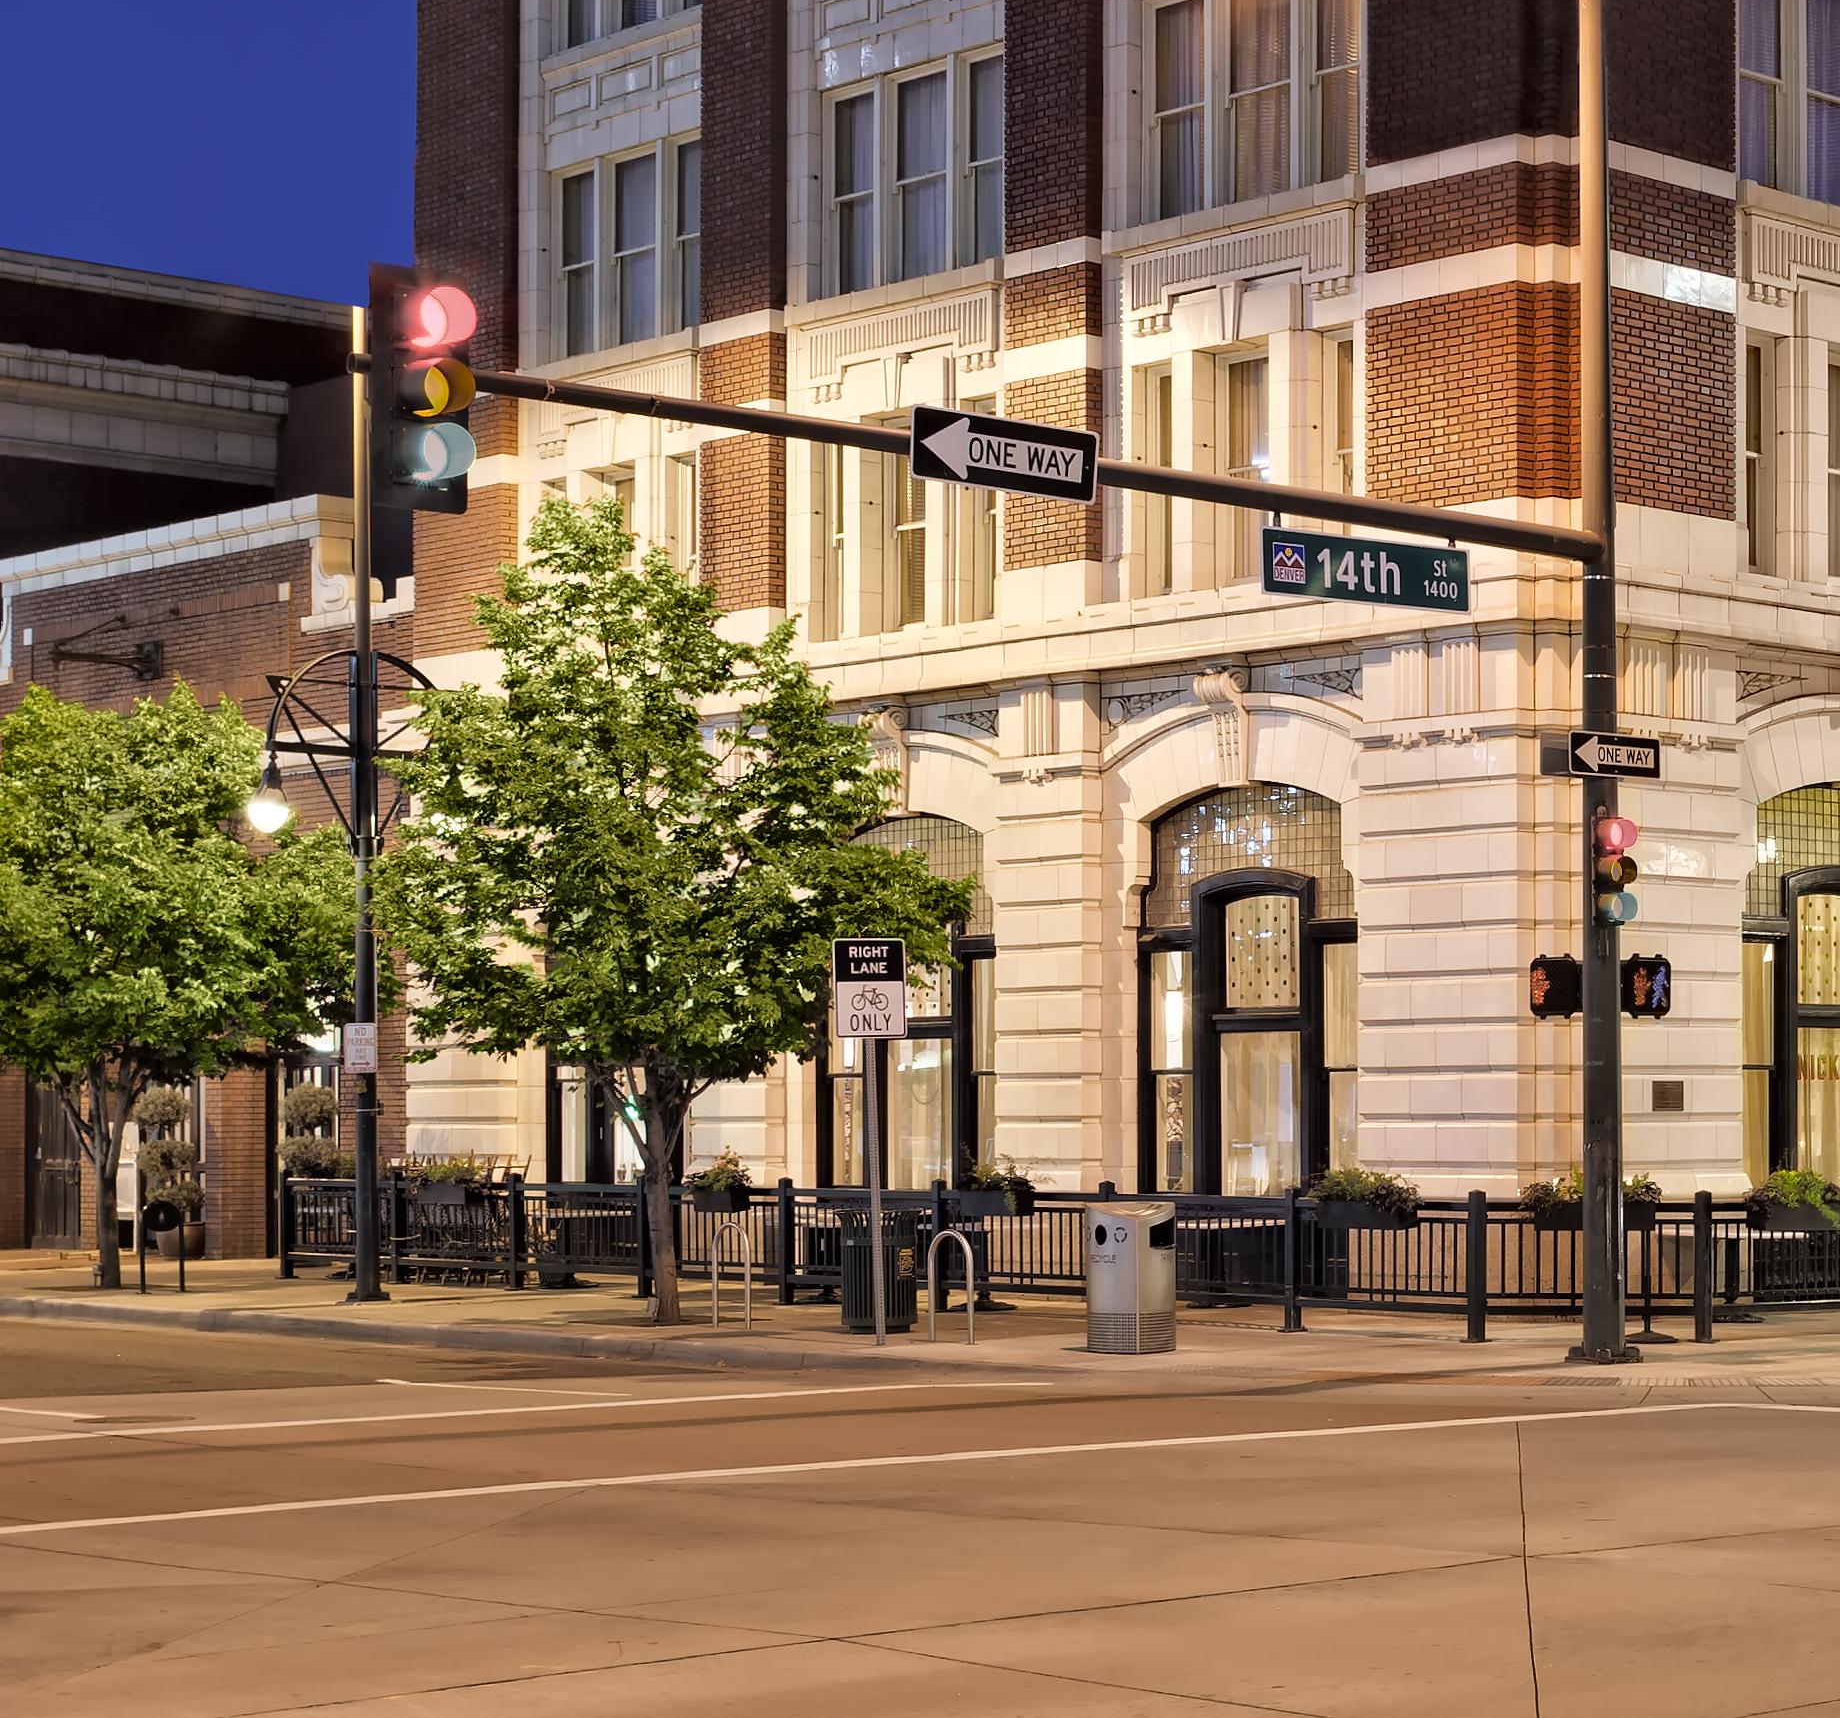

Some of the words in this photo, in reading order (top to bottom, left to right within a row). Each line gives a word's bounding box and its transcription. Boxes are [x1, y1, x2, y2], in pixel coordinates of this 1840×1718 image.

[969, 437, 1017, 469] ONE
[1027, 445, 1077, 477] WAY
[1274, 567, 1306, 582] DENVER
[1316, 548, 1401, 596] 14th
[1433, 560, 1448, 578] St
[1423, 579, 1459, 600] 1400
[1598, 746, 1622, 763] ONE
[1625, 748, 1651, 766] WAY
[848, 946, 889, 958] RIGHT
[850, 962, 888, 975] LANE
[850, 1014, 892, 1032] ONLY
